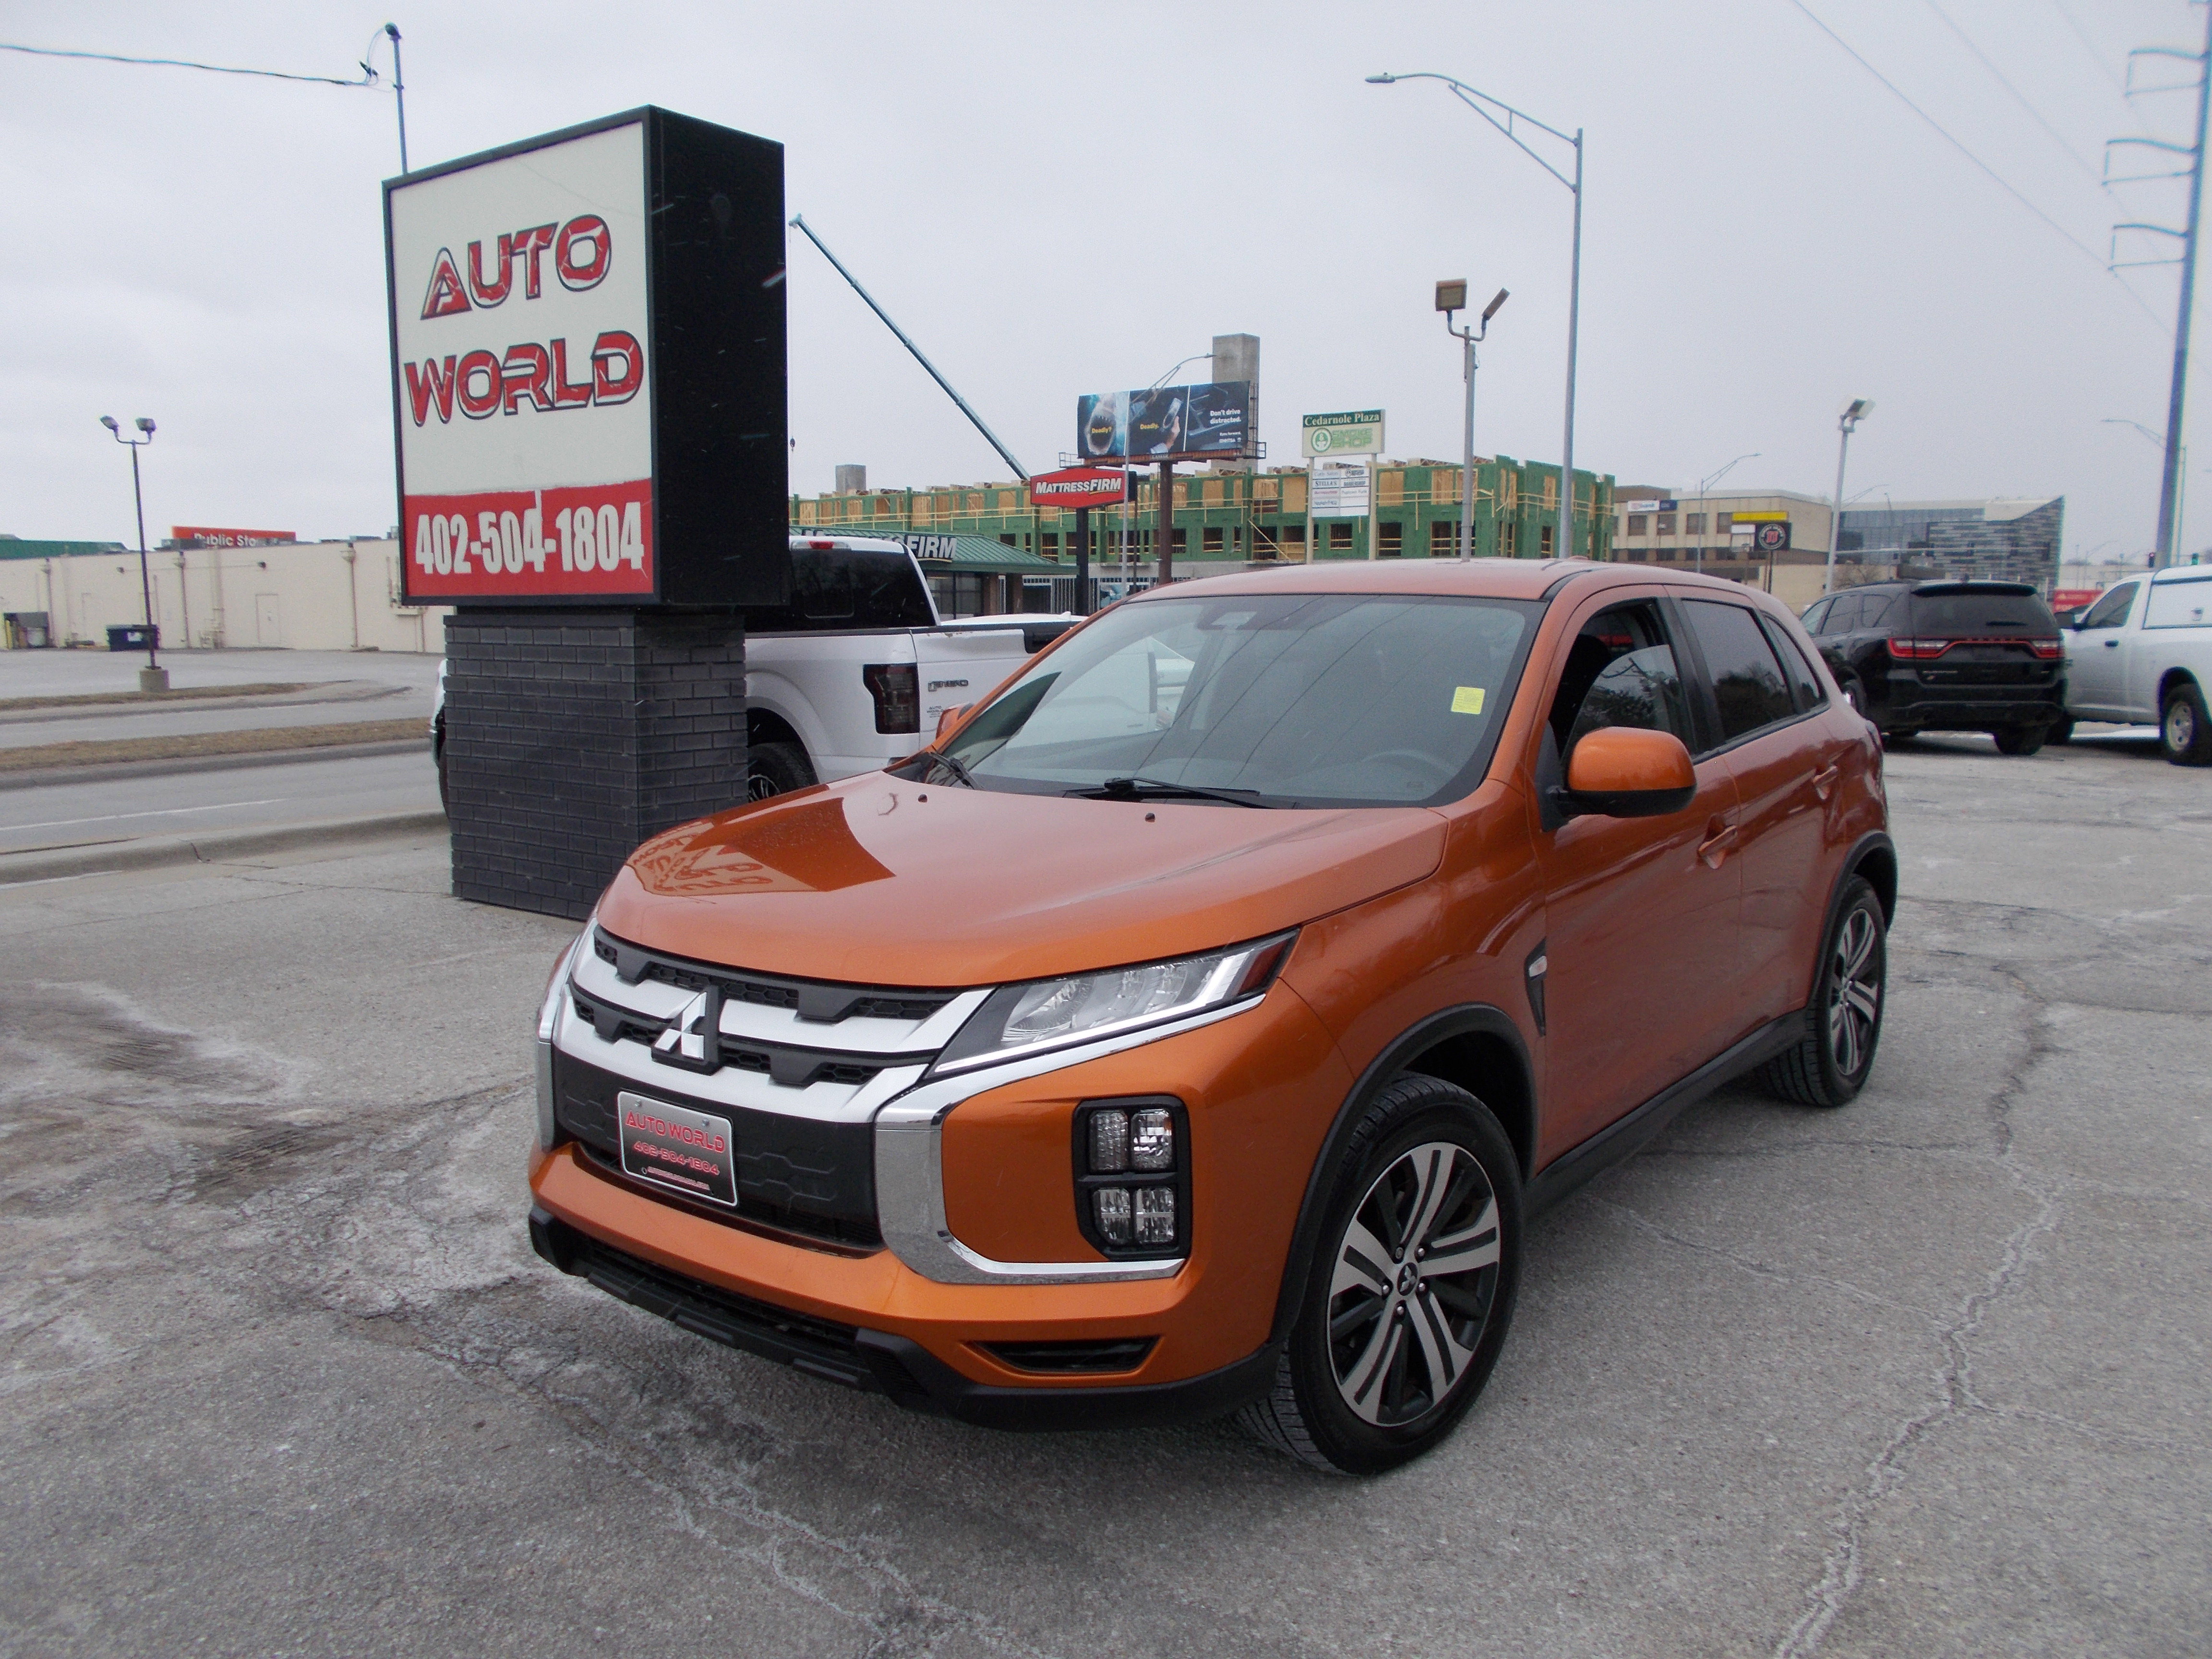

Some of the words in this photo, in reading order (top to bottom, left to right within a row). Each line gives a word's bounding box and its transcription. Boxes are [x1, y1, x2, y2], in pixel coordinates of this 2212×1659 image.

[421, 214, 612, 320] AUTO
[404, 330, 644, 427] WORLD
[1305, 414, 1352, 426] Cedarnole
[1354, 412, 1379, 422] Plaza
[1332, 437, 1373, 448] SHOP
[416, 500, 644, 576] 402-504-1804
[626, 1111, 666, 1136] AUTO
[669, 1121, 725, 1153] WORLD
[633, 1141, 720, 1176] 402-504-1804
